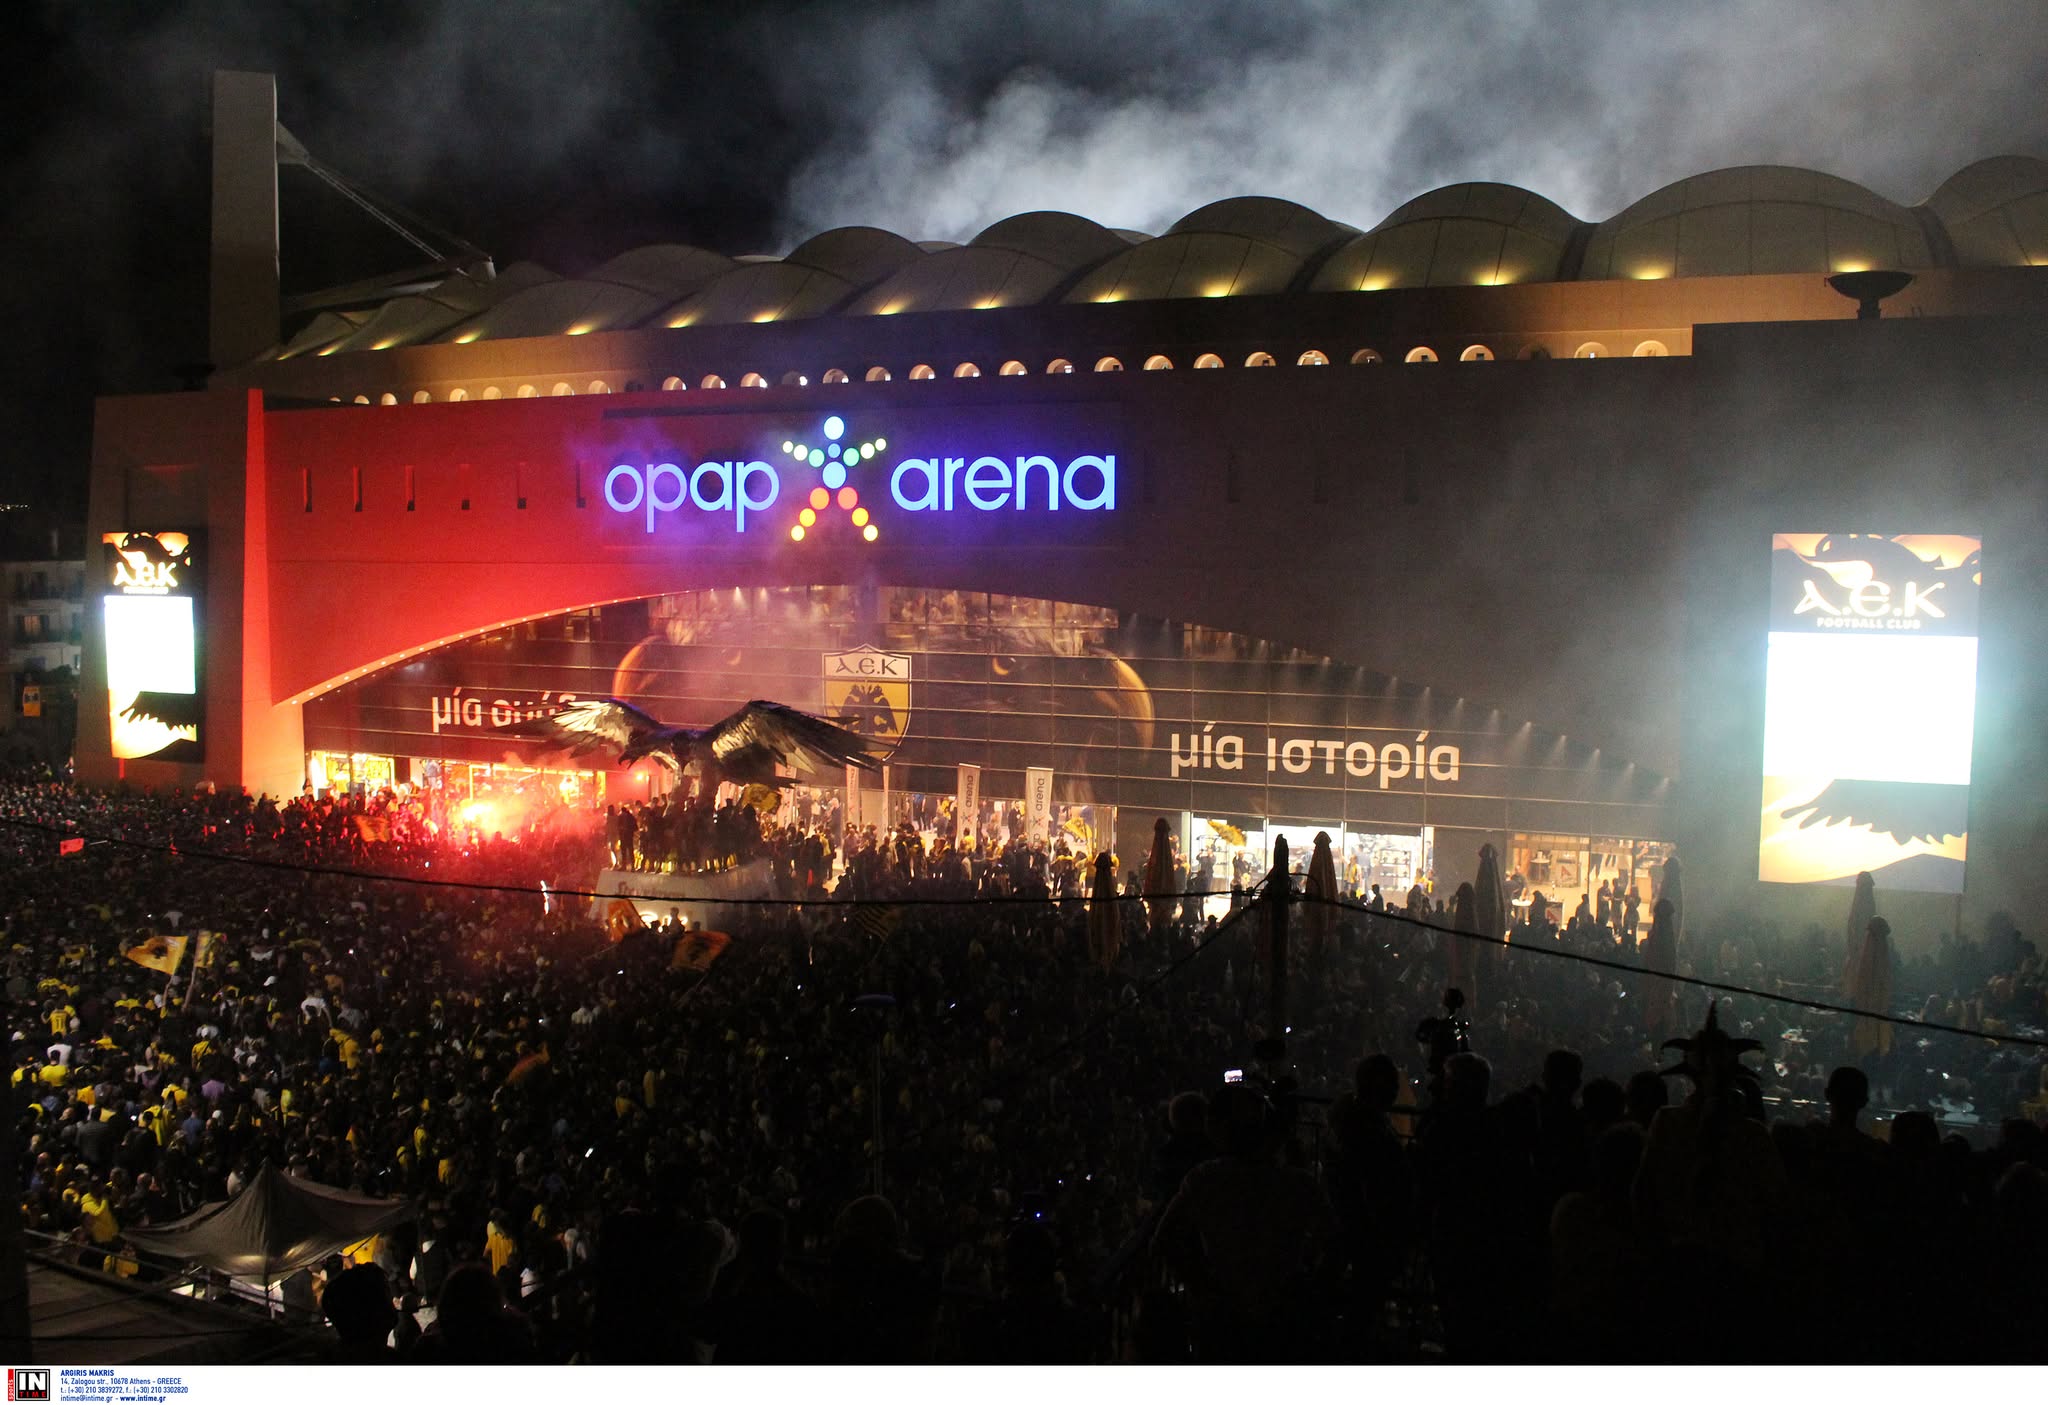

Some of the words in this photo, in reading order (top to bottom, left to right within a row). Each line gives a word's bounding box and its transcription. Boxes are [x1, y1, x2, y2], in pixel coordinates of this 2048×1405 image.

[604, 461, 780, 533] opap
[890, 455, 1116, 511] arena
[1816, 617, 1884, 629] FOOTBALL
[1886, 618, 1921, 630] CLUB
[432, 686, 482, 733] μία
[1170, 721, 1244, 778] μία
[1267, 730, 1460, 789] ιστορία
[1035, 777, 1045, 812] arena
